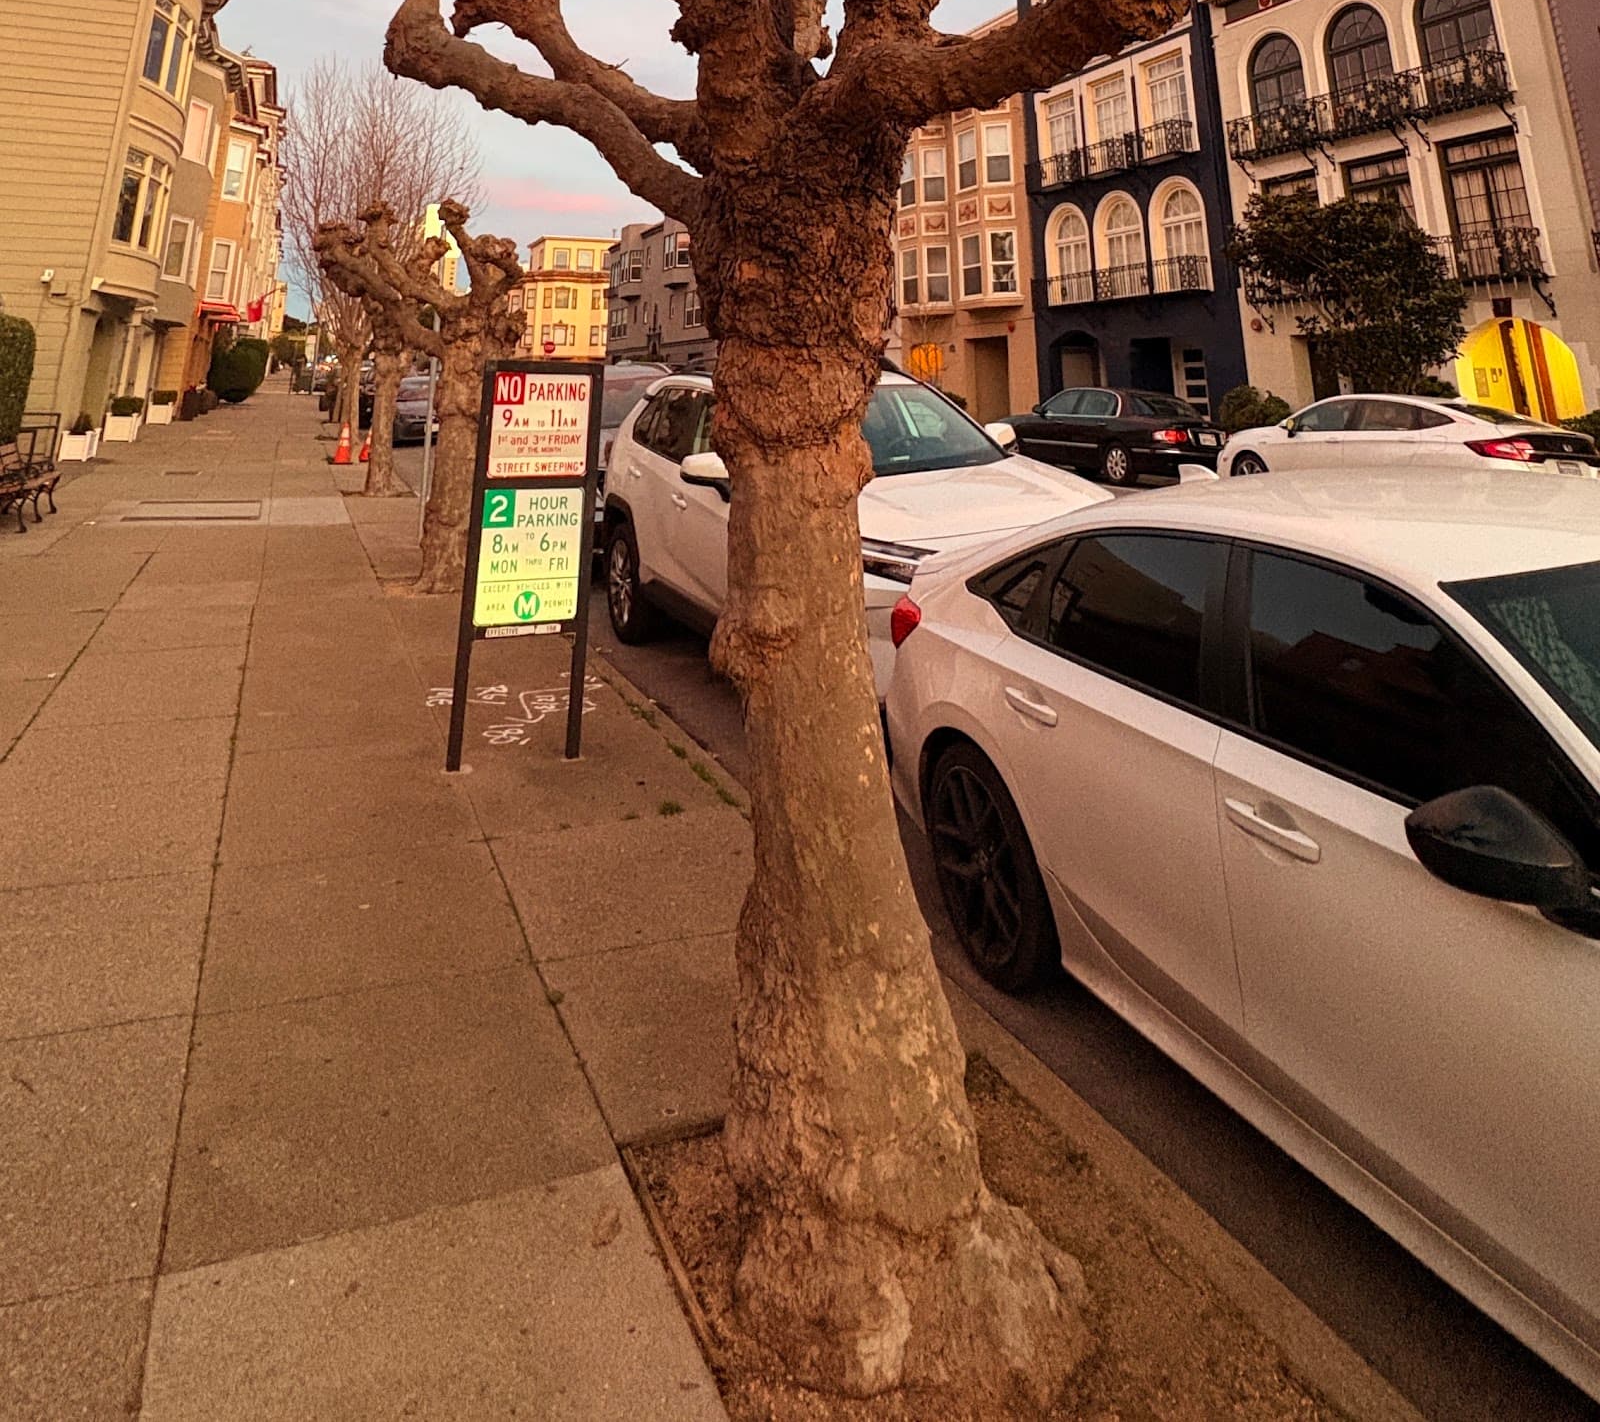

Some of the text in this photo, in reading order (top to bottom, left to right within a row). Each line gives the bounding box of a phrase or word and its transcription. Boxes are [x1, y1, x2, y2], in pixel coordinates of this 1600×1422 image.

[497, 376, 587, 402] NO PARKING
[498, 434, 582, 446] 1st and 3rd FRIDAY
[496, 461, 580, 473] STREET SWEEPING
[489, 495, 568, 522] 2 HOUR
[517, 512, 578, 527] PARKING
[490, 557, 569, 574] MON THRU FRI
[483, 580, 573, 593] EXCEPT VEHICLES WITH
[486, 593, 573, 617] AREA M PERMITS
